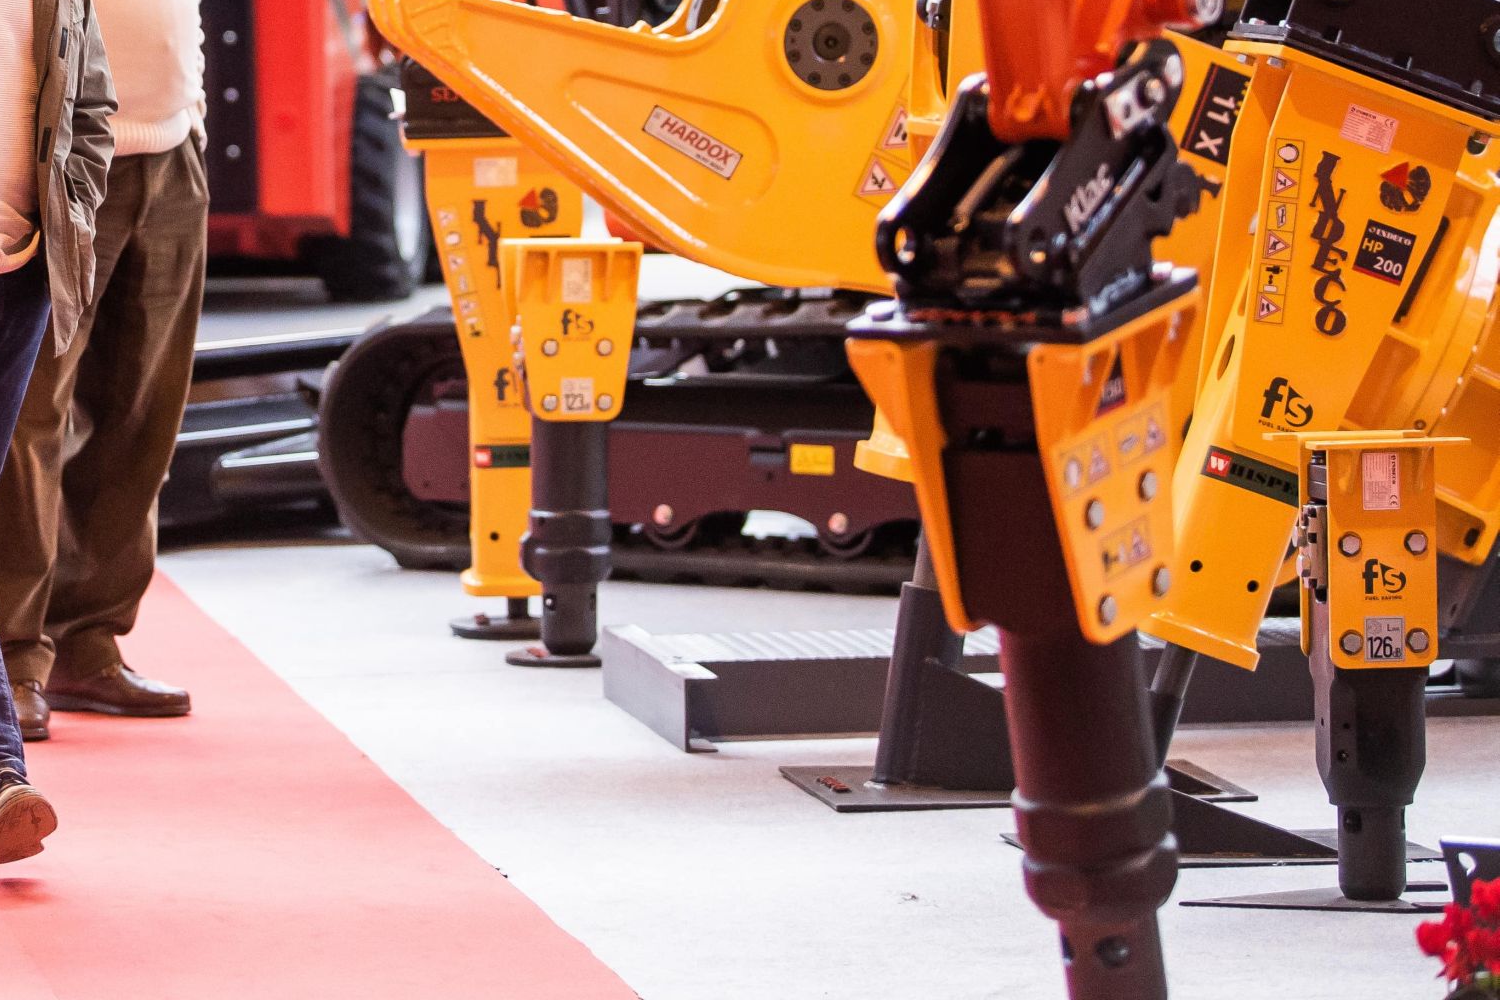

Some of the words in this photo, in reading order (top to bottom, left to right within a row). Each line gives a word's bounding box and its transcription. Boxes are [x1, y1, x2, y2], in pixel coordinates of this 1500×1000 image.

[660, 116, 734, 166] HARDOX
[1309, 151, 1347, 337] INDECO
[1362, 237, 1385, 254] HP
[1373, 256, 1404, 277] 200
